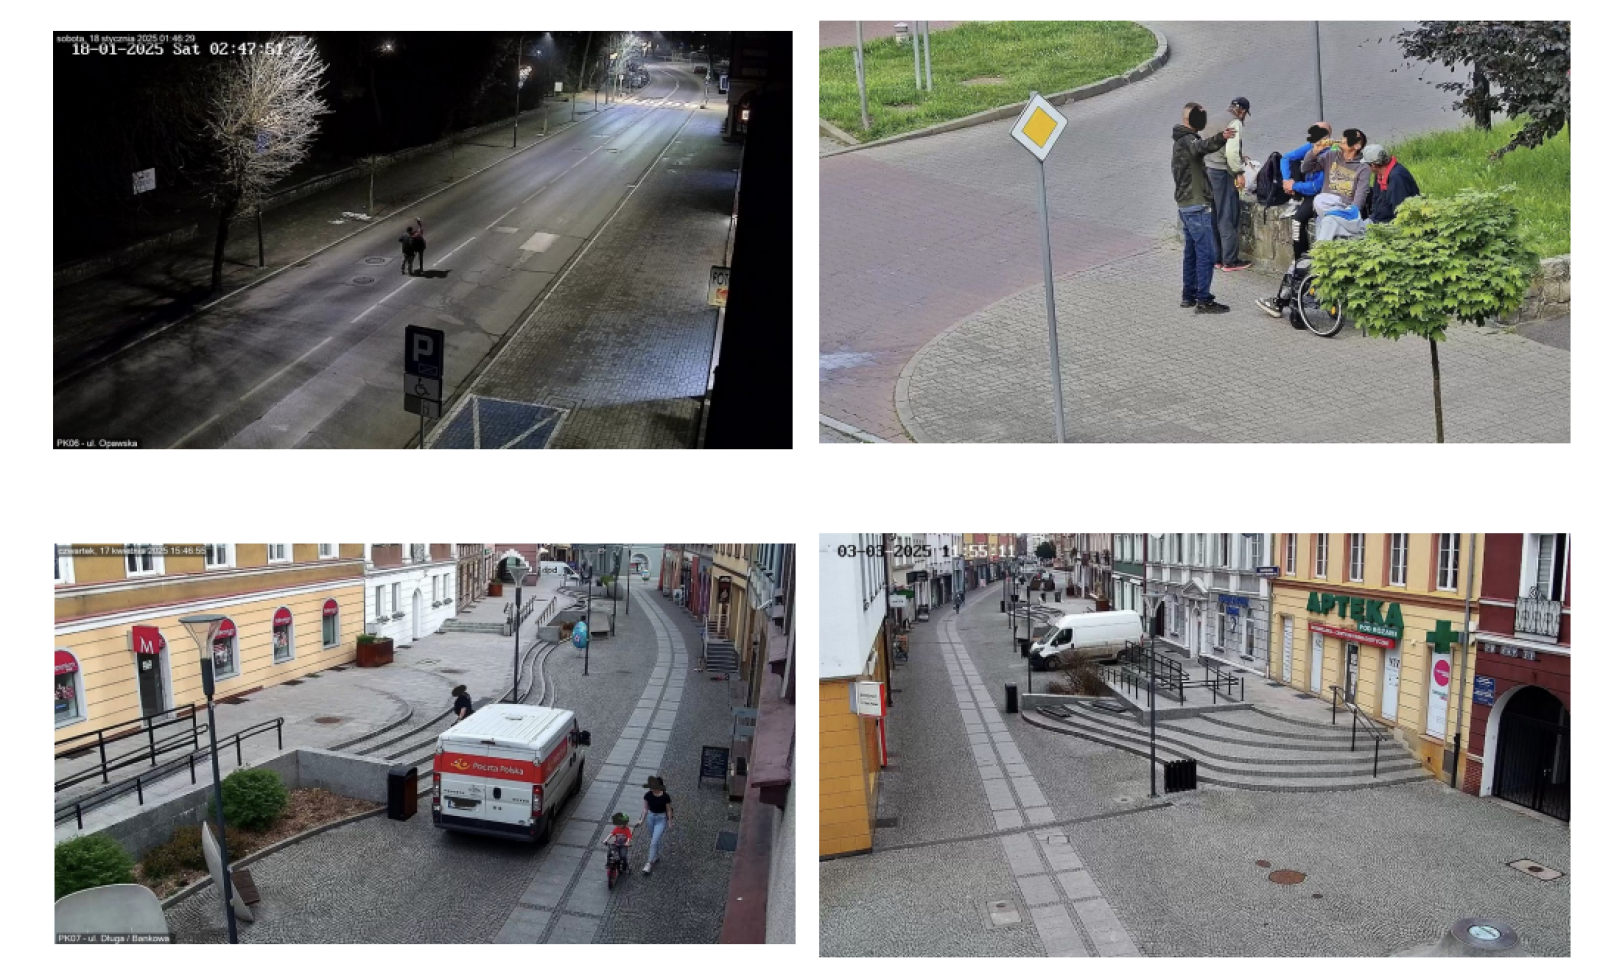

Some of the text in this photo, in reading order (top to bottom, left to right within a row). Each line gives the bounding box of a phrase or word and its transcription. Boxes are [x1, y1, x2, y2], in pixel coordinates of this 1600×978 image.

[414, 333, 434, 362] P
[1306, 592, 1404, 630] APTEKA
[140, 636, 154, 654] M
[472, 762, 524, 776] Poczta Polska
